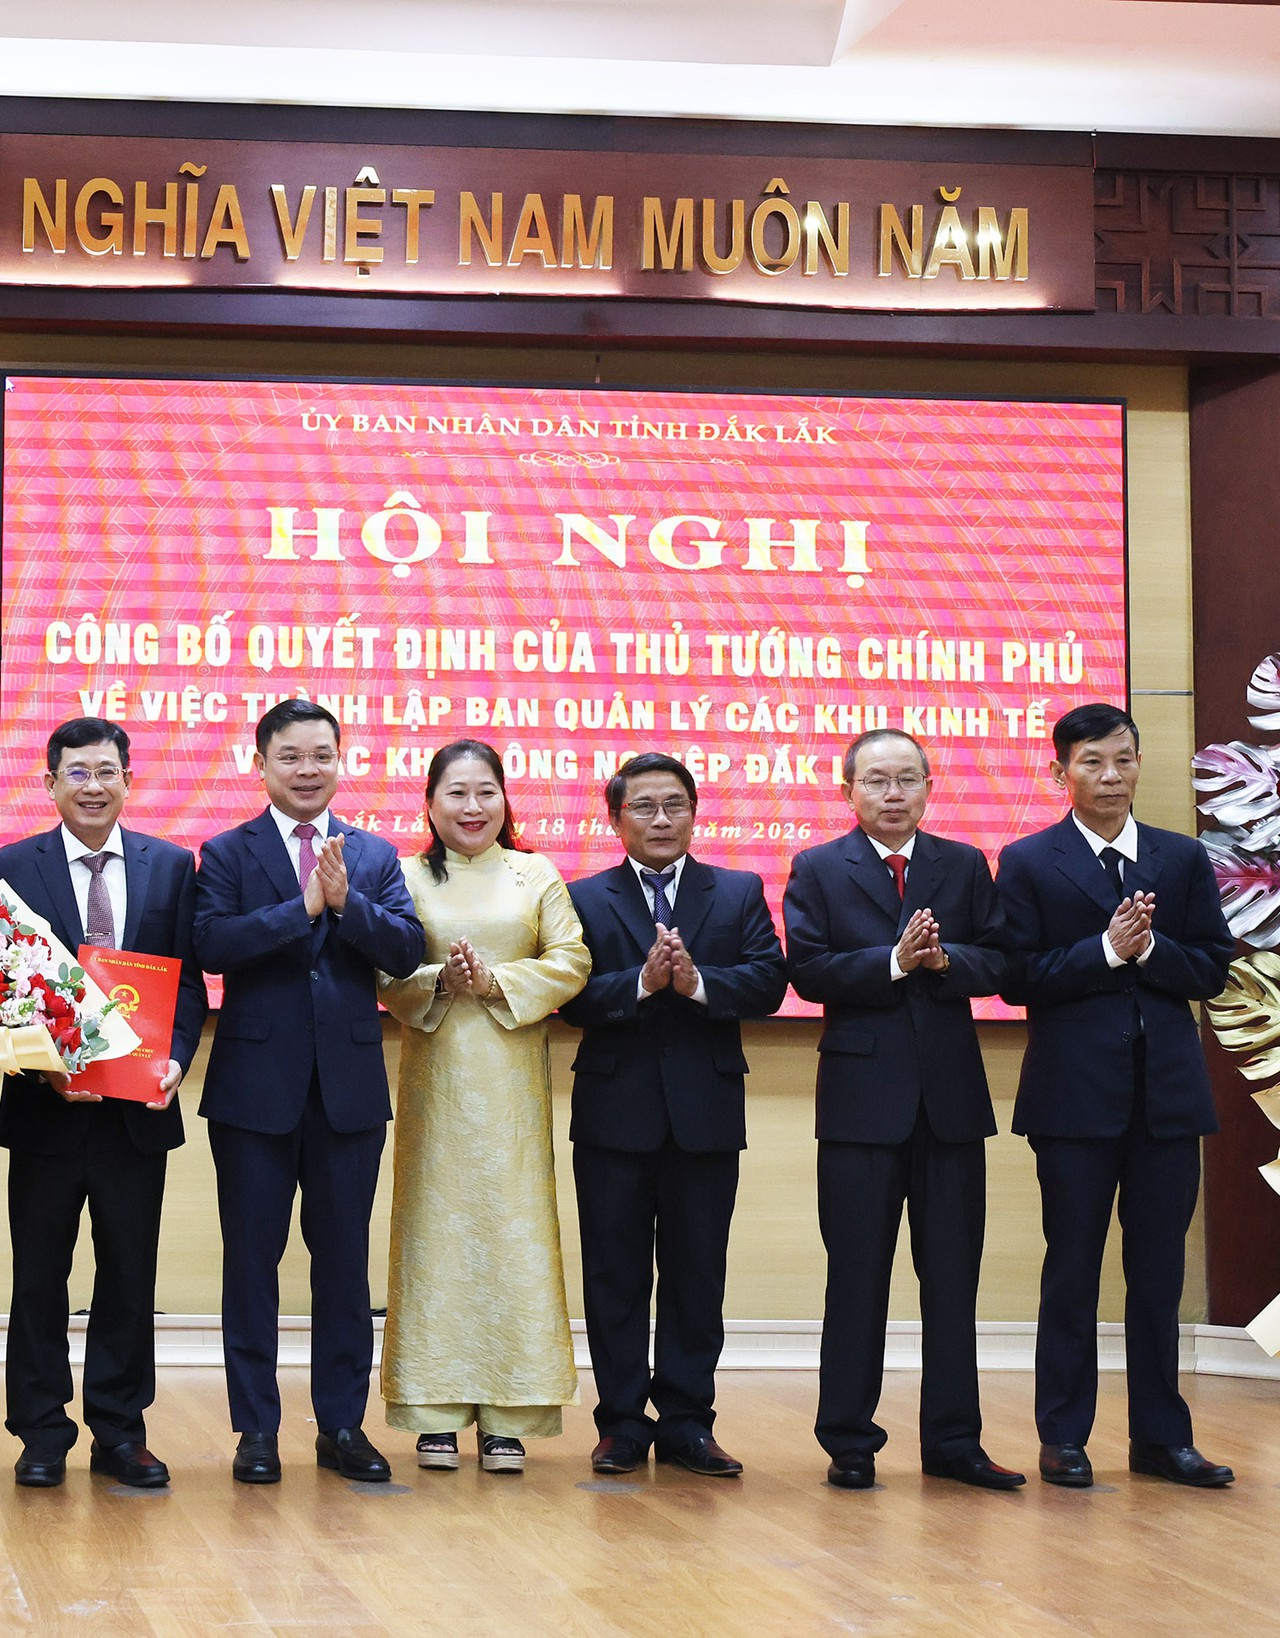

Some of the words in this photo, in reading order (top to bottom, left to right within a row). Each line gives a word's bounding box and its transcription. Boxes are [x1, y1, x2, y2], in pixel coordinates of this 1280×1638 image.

[21, 161, 251, 261] NGHĨA
[269, 166, 436, 276] VIỆT
[458, 190, 616, 272] NAM
[640, 177, 851, 279] MUÔN
[876, 185, 1031, 283] NĂM
[301, 407, 343, 432] ỦY
[352, 413, 417, 434] BAN
[426, 413, 521, 437] NHÂN
[531, 415, 600, 439] DÂN
[610, 415, 689, 441] TỈNH
[697, 415, 767, 443] ĐẮK
[774, 417, 838, 445] LẮK
[263, 491, 496, 578] HỘI
[552, 512, 874, 589] NGHỊ
[45, 613, 160, 667] CÔNG
[176, 610, 236, 668] BỐ
[248, 613, 381, 675] QUYẾT
[394, 628, 497, 678] ĐỊNH
[513, 618, 596, 674] CỦA
[610, 622, 691, 677] THỦ
[706, 628, 842, 679] TƯỚNG
[858, 630, 986, 682] CHÍNH
[1003, 630, 1084, 685] PHỦ
[79, 680, 126, 721] VỀ
[140, 685, 228, 728] VIỆC
[383, 689, 452, 731] LẬP
[466, 697, 540, 728] BAN
[554, 691, 655, 731] QUẢN
[670, 695, 712, 731] LÝ
[725, 695, 800, 733] CÁC
[814, 704, 888, 734] KHU
[903, 706, 990, 737] KINH
[1003, 698, 1052, 738] TẾ
[387, 747, 442, 777] KH
[503, 742, 579, 779] ÔNG
[743, 743, 819, 785] ĐẮK
[536, 817, 566, 835] 18
[692, 821, 742, 838] năm
[751, 822, 812, 840] 2026
